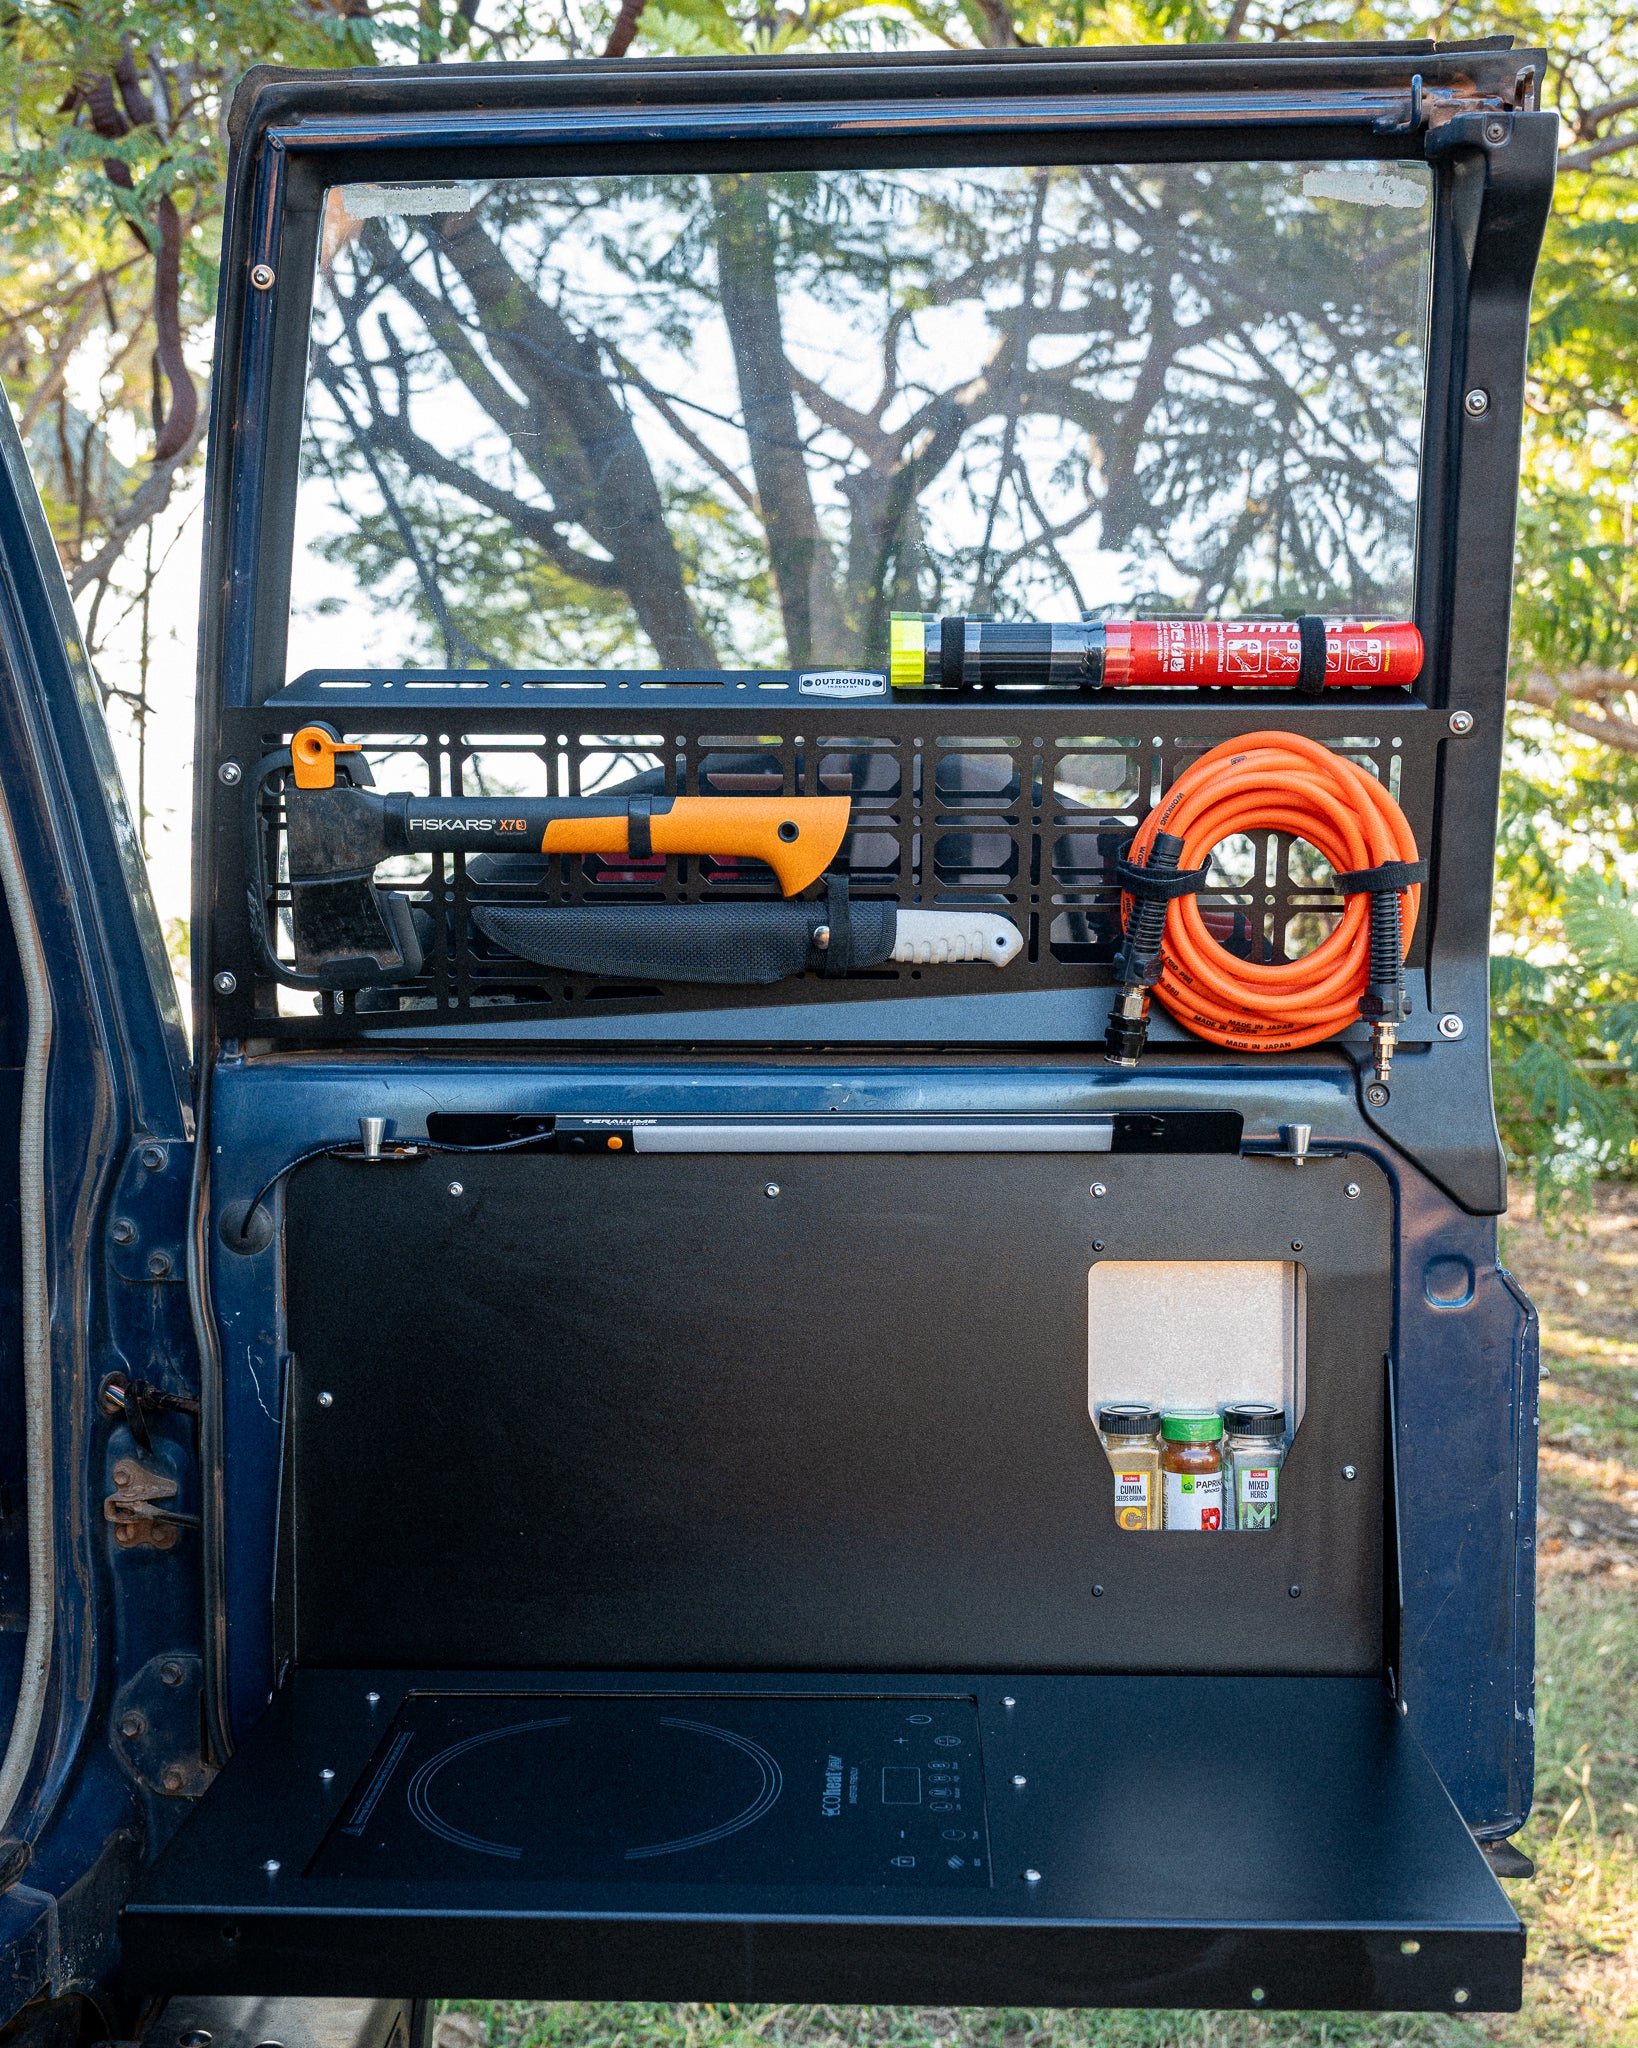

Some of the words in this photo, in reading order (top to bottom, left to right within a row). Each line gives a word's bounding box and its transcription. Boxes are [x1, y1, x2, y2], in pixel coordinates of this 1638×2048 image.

[1289, 642, 1298, 650] 3
[1329, 643, 1338, 651] 2
[814, 678, 871, 687] OUTBOUND
[1160, 792, 1185, 826] WORKING
[1194, 1015, 1217, 1027] MADE
[1228, 1019, 1251, 1028] MADE
[1267, 1023, 1295, 1031] JAPAN
[1225, 1039, 1248, 1049] MADE
[1264, 1041, 1292, 1050] JAPAN
[1120, 1485, 1142, 1495] CUMIN
[1248, 1480, 1270, 1490] MIXED
[1250, 1490, 1268, 1499] HERBS
[1120, 1506, 1143, 1530] C
[1247, 1502, 1271, 1529] M
